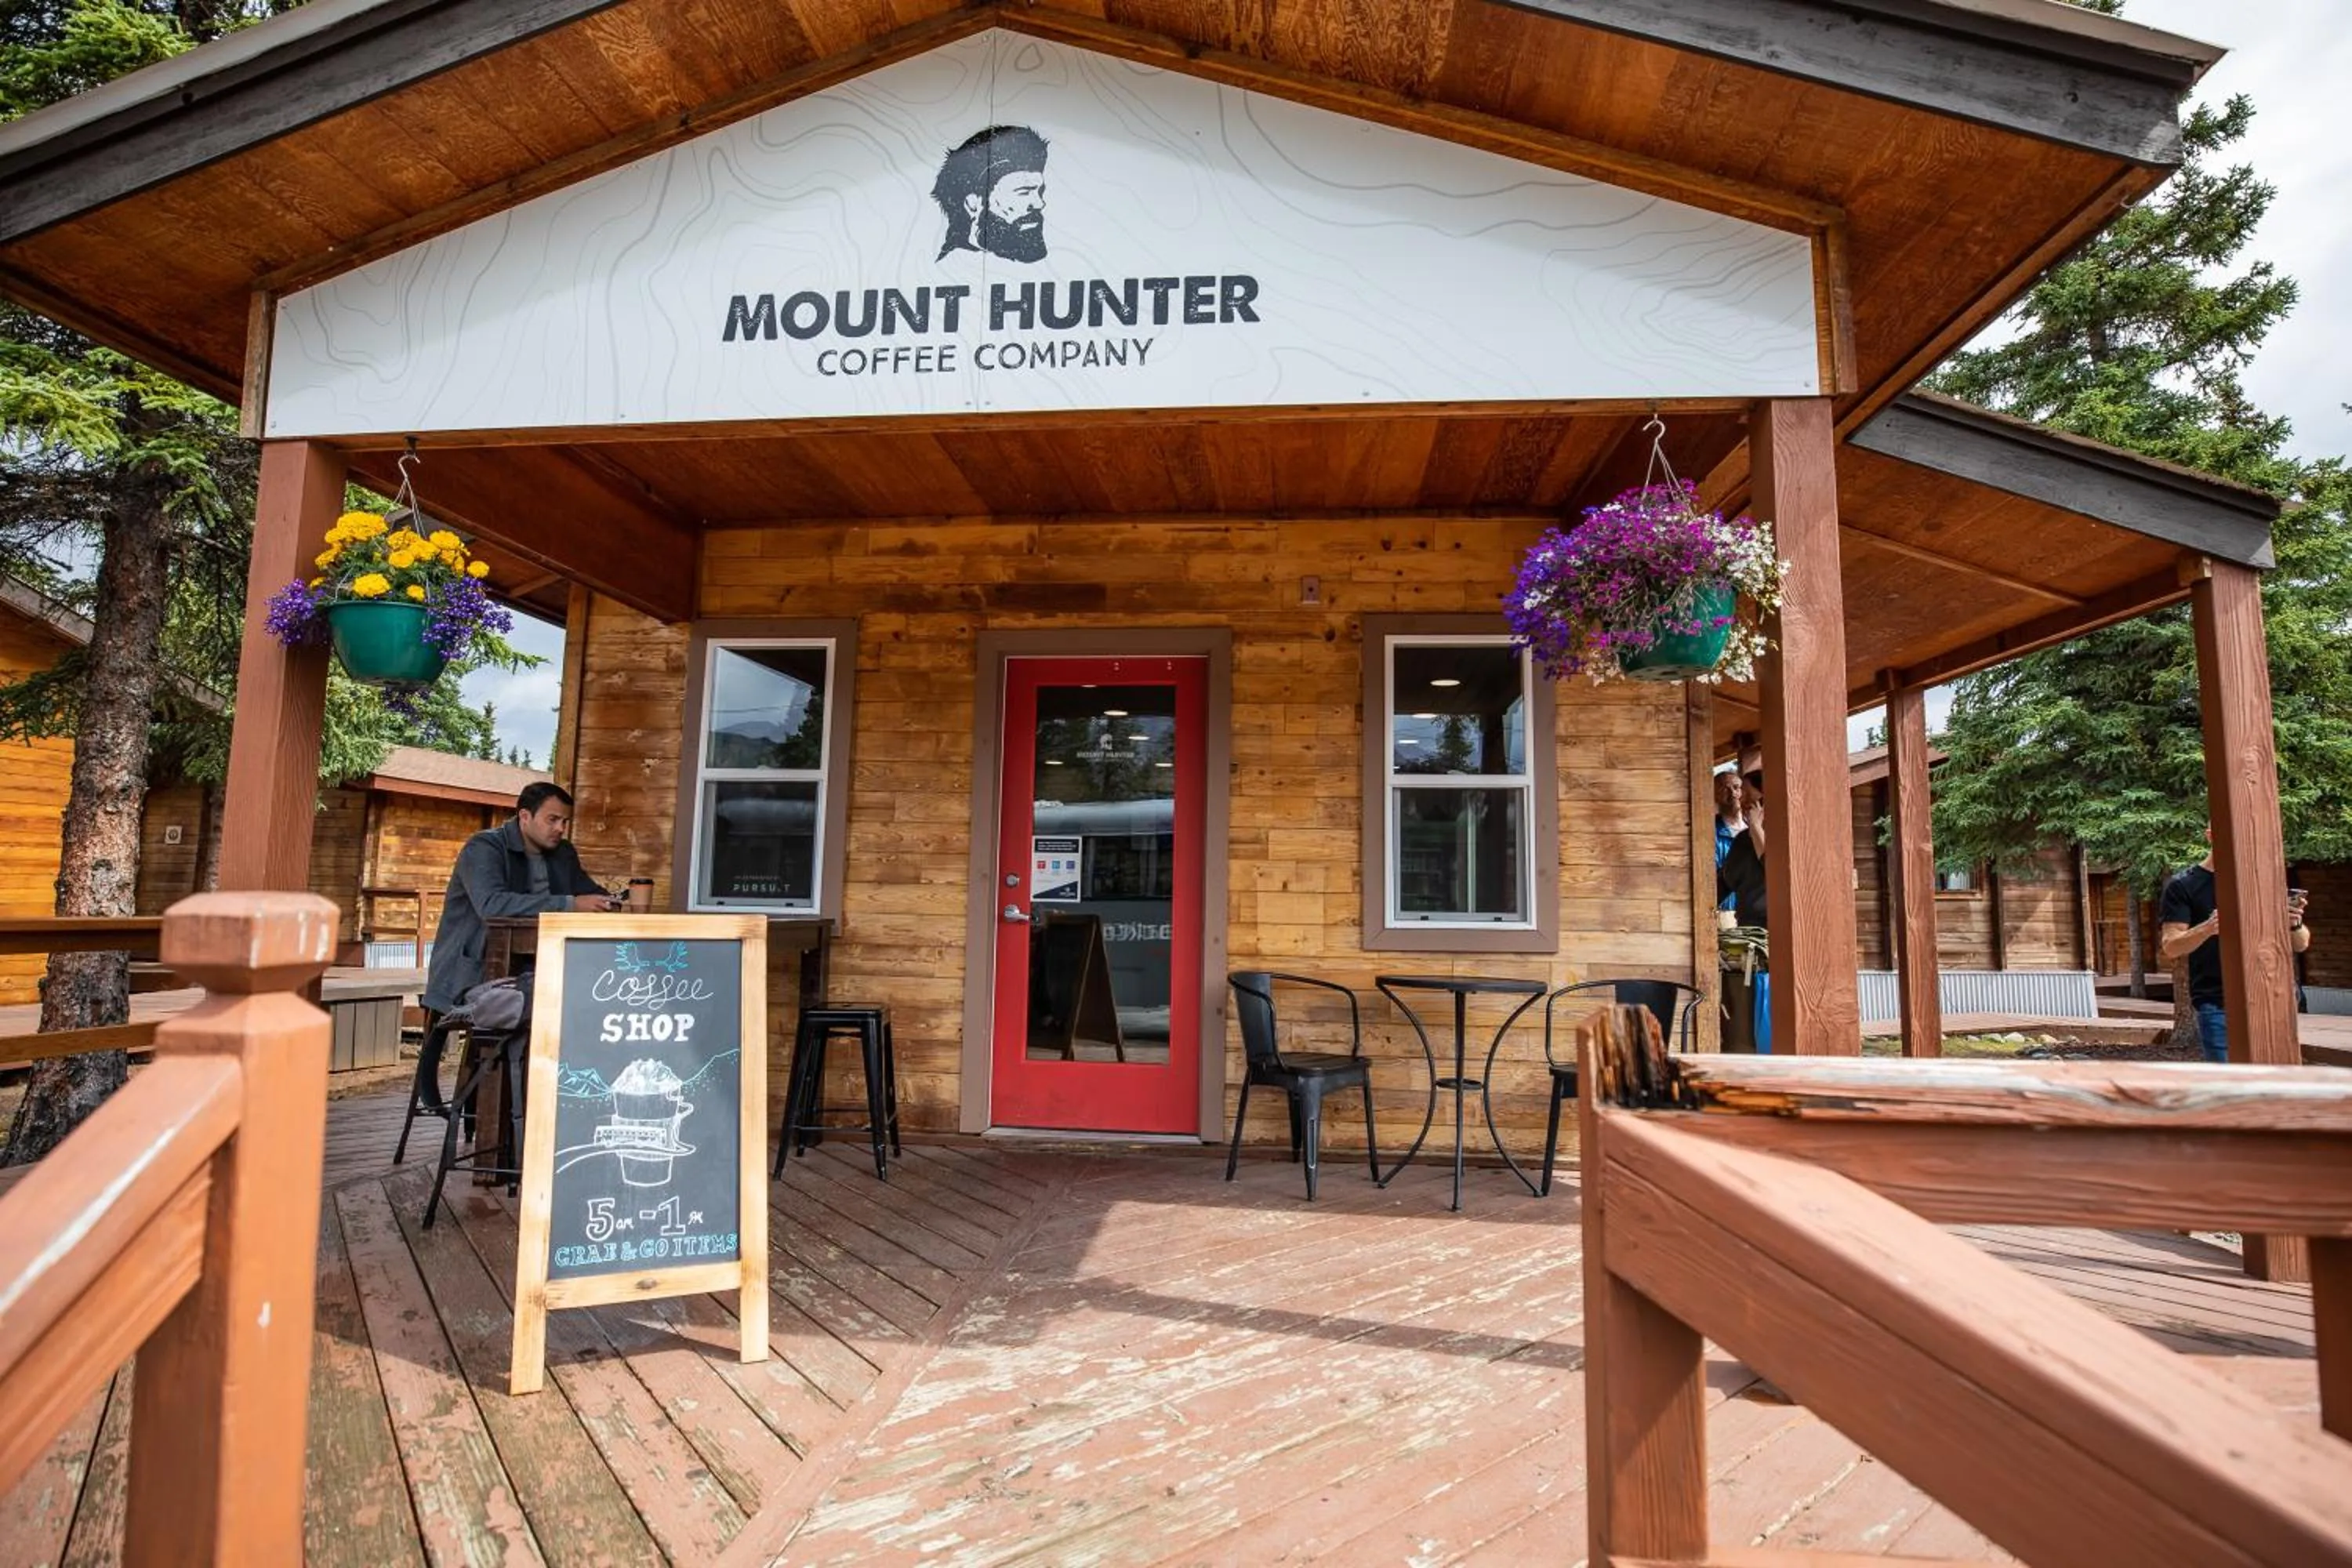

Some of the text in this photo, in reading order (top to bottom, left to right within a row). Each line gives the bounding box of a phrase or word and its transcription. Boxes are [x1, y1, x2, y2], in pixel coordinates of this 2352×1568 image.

[722, 274, 1260, 341] MOUNT HUNTER
[816, 338, 1153, 376] COFFEE COMPANY
[592, 970, 714, 1010] Coffee
[601, 1014, 695, 1042] SHOP
[554, 1232, 738, 1267] GRAB & GO ITEMS
